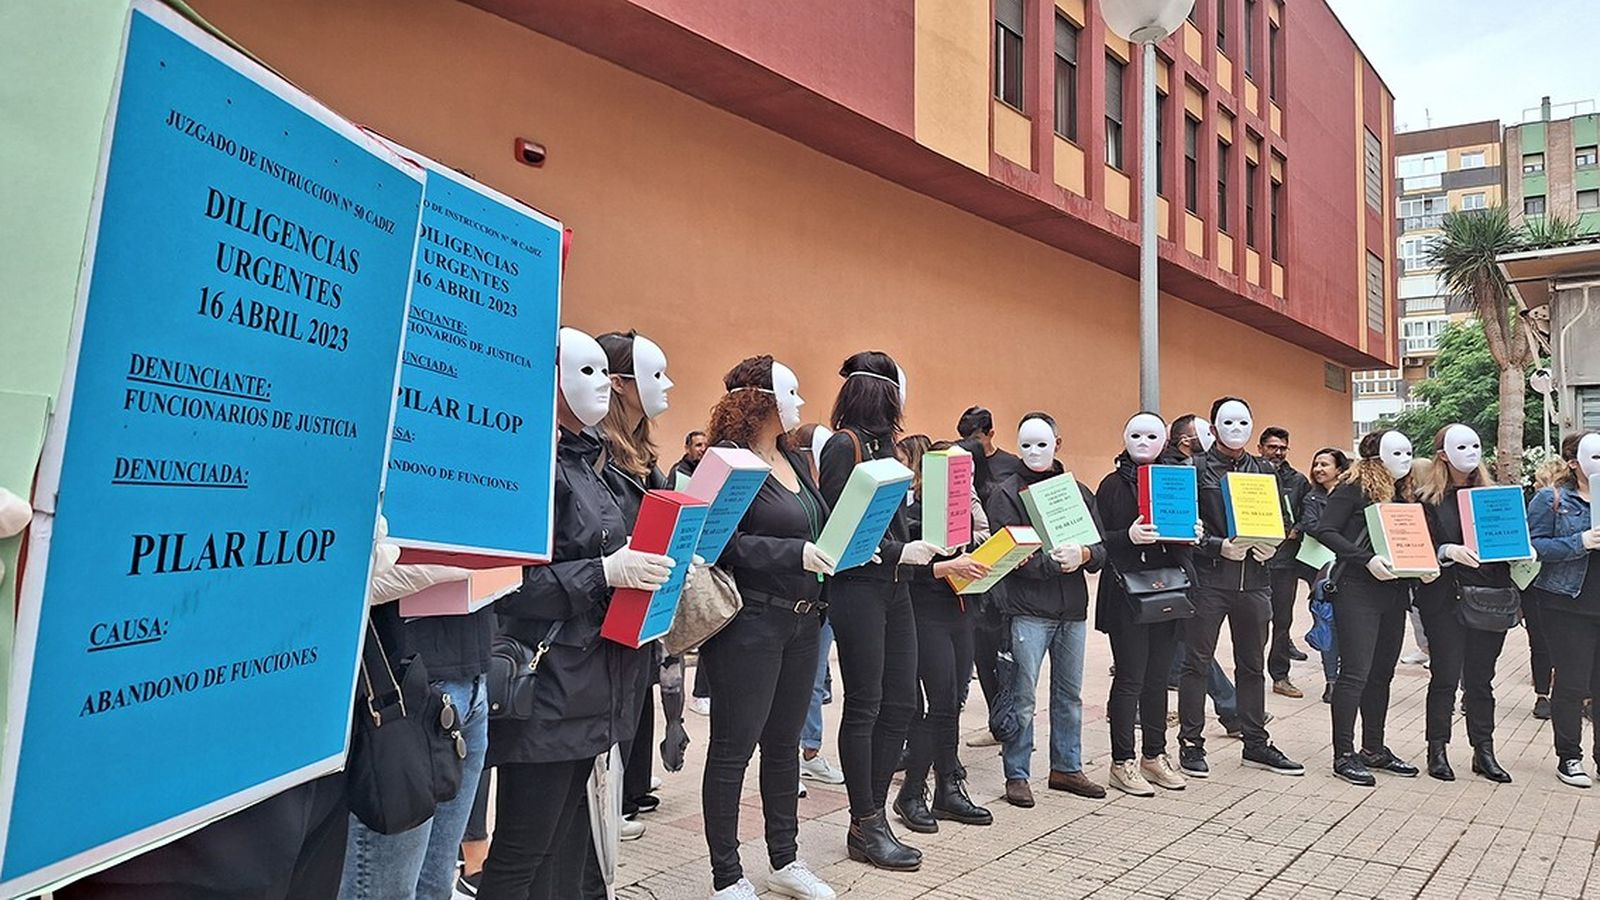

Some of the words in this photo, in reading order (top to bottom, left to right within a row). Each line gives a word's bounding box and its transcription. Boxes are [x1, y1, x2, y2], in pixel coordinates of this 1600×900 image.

[166, 109, 237, 156] JUZGADO
[239, 145, 257, 167] DE
[259, 156, 340, 208] INSTRUCCION
[353, 204, 365, 219] 50
[365, 210, 396, 235] CADIZ
[205, 186, 360, 275] DILIGENCIAS
[431, 203, 443, 214] DE
[445, 208, 500, 239] INSTRUCCION
[216, 242, 342, 309] URGENTES
[415, 269, 432, 287] 16
[435, 277, 486, 307] ABRIL
[488, 296, 518, 318] 2023
[424, 248, 510, 294] URGENTES
[197, 287, 225, 319] 16
[228, 297, 303, 341] ABRIL
[307, 318, 349, 352] 2023
[409, 305, 468, 336] NCIANTE:
[402, 350, 459, 378] UNCIADA:
[409, 320, 468, 349] IONARIOS
[469, 340, 484, 352] DE
[487, 346, 533, 369] JUSTICIA
[127, 353, 273, 402] DENUNCIANTE:
[123, 388, 268, 428] FUNCIONARIOS
[272, 410, 293, 431] DE
[295, 414, 358, 438] JUSTICIA
[467, 402, 523, 434] LLOP
[112, 457, 249, 489] DENUNCIADA:
[439, 468, 456, 481] DE
[457, 471, 519, 492] FUNCIONES
[127, 531, 246, 576] PILAR
[253, 528, 336, 567] LLOP
[87, 617, 169, 652] CAUSA:
[79, 671, 199, 717] ABANDONO
[203, 665, 228, 688] DE
[230, 646, 319, 683] FUNCIONES
